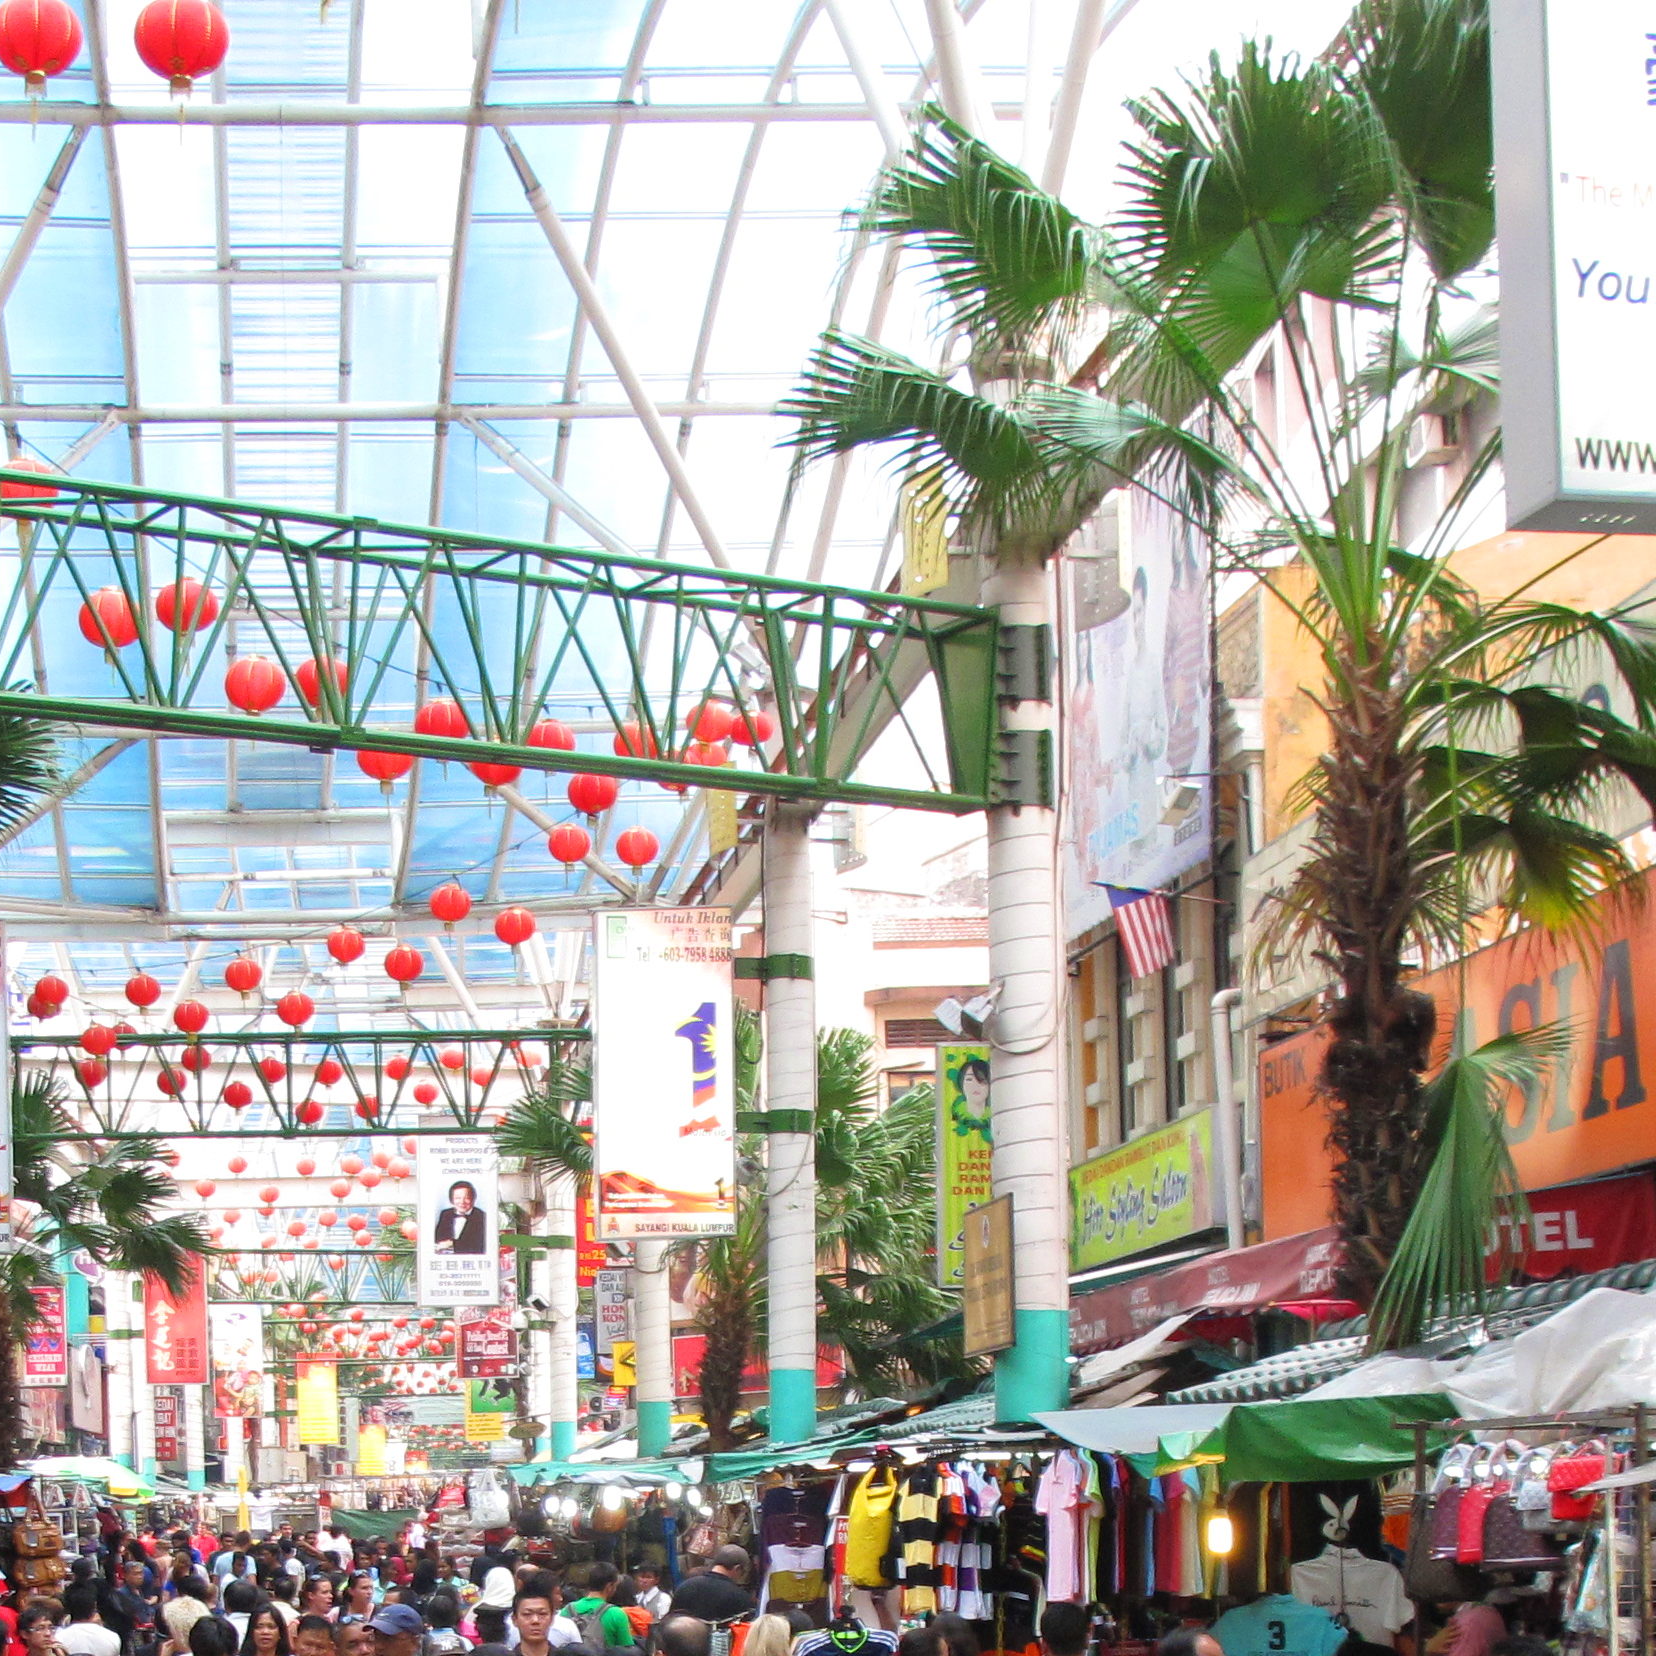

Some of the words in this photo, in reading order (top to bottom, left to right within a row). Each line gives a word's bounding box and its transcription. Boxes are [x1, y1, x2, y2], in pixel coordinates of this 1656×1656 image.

[1572, 257, 1649, 304] You
[654, 912, 693, 924] Untuk
[697, 911, 732, 924] Iklan
[1264, 1047, 1306, 1099] BUTIK
[635, 1224, 670, 1233] SAYANGI
[672, 1224, 699, 1232] KUALA
[700, 1223, 734, 1232] LUMPUR
[1268, 1620, 1286, 1650] 3
